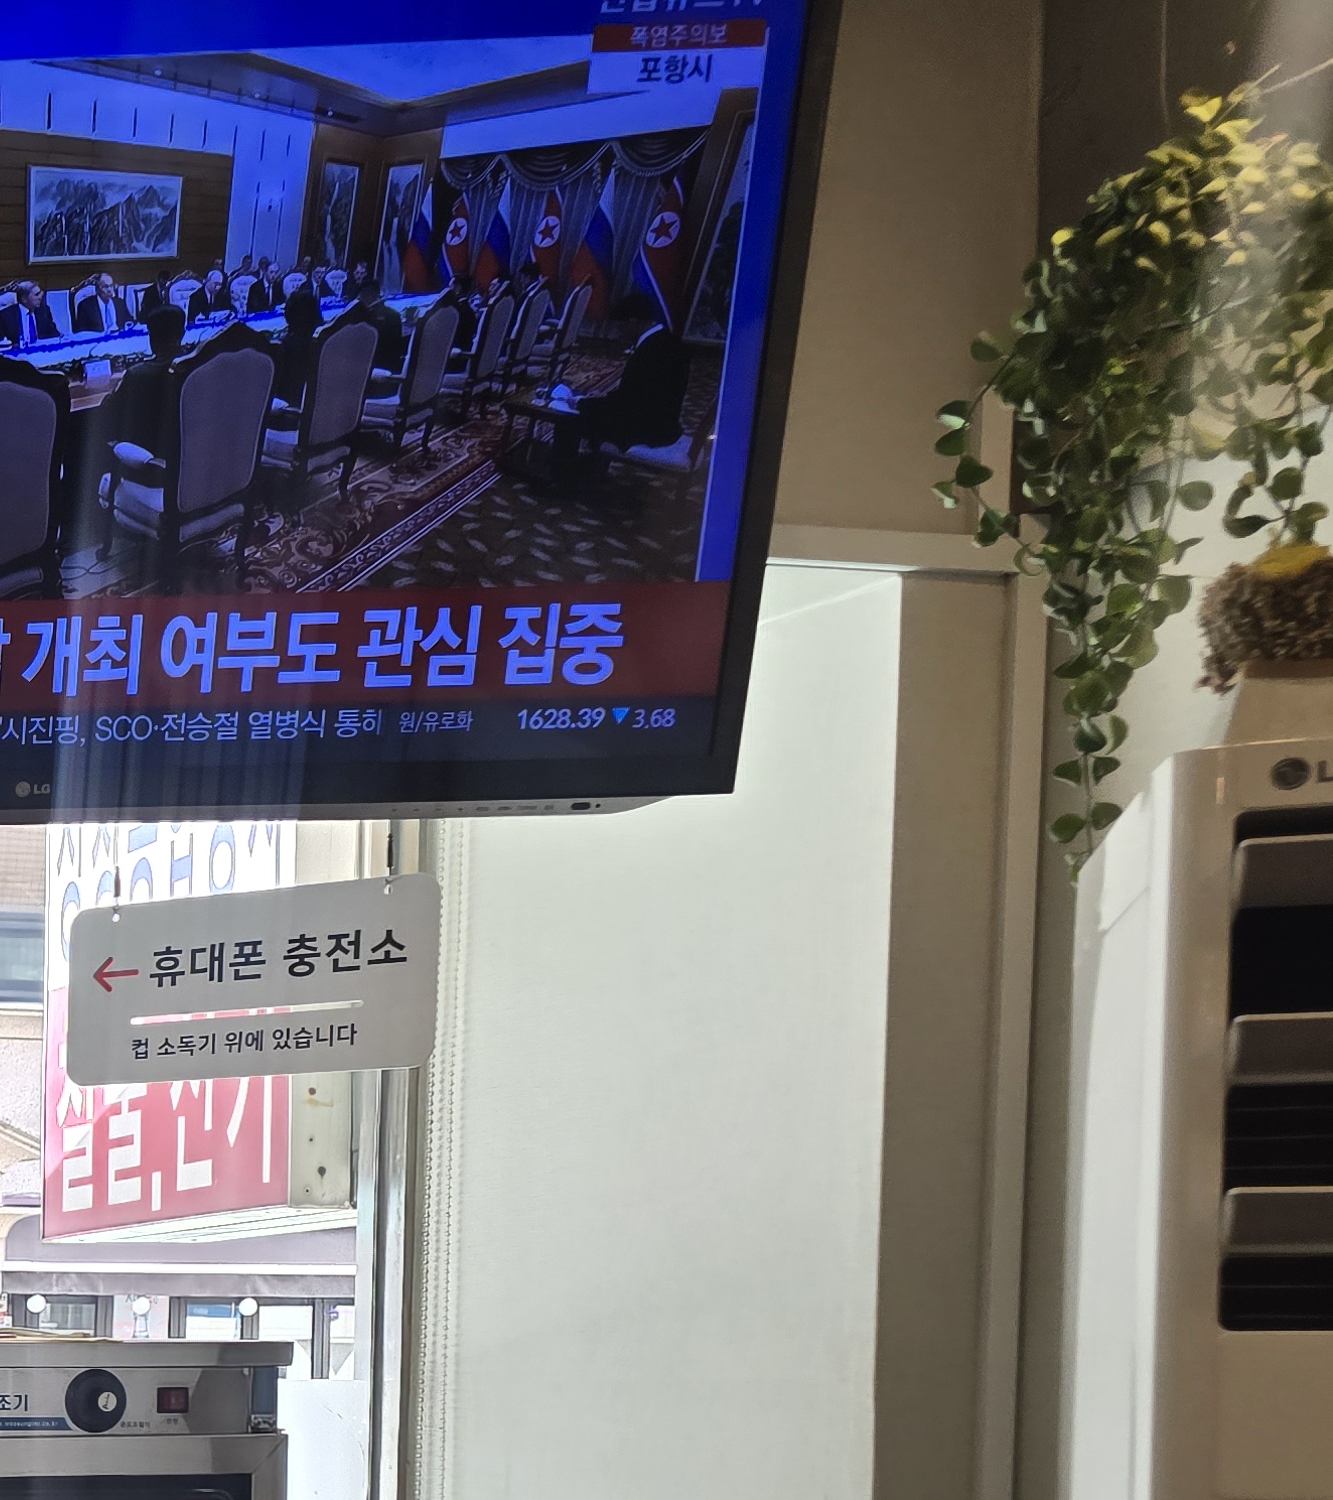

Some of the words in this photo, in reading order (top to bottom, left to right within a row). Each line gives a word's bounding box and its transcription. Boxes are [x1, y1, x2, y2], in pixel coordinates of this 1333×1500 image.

[637, 54, 712, 83] 포항시
[22, 614, 141, 697] 개최
[160, 610, 339, 693] 여부도
[357, 605, 481, 688] 관심
[499, 603, 623, 686] 집중
[248, 709, 324, 739] 열병식
[399, 710, 474, 735] 원/유로화
[517, 708, 605, 730] 1628.39
[632, 708, 675, 729] 3.68
[1317, 760, 1333, 783] L
[34, 784, 50, 794] LG
[149, 939, 266, 988] 휴대폰
[282, 929, 408, 975] 충전소
[131, 1037, 149, 1060] 컵
[156, 1031, 216, 1057] 소독기
[224, 1028, 263, 1054] 위에
[272, 1023, 357, 1052] 있습니다
